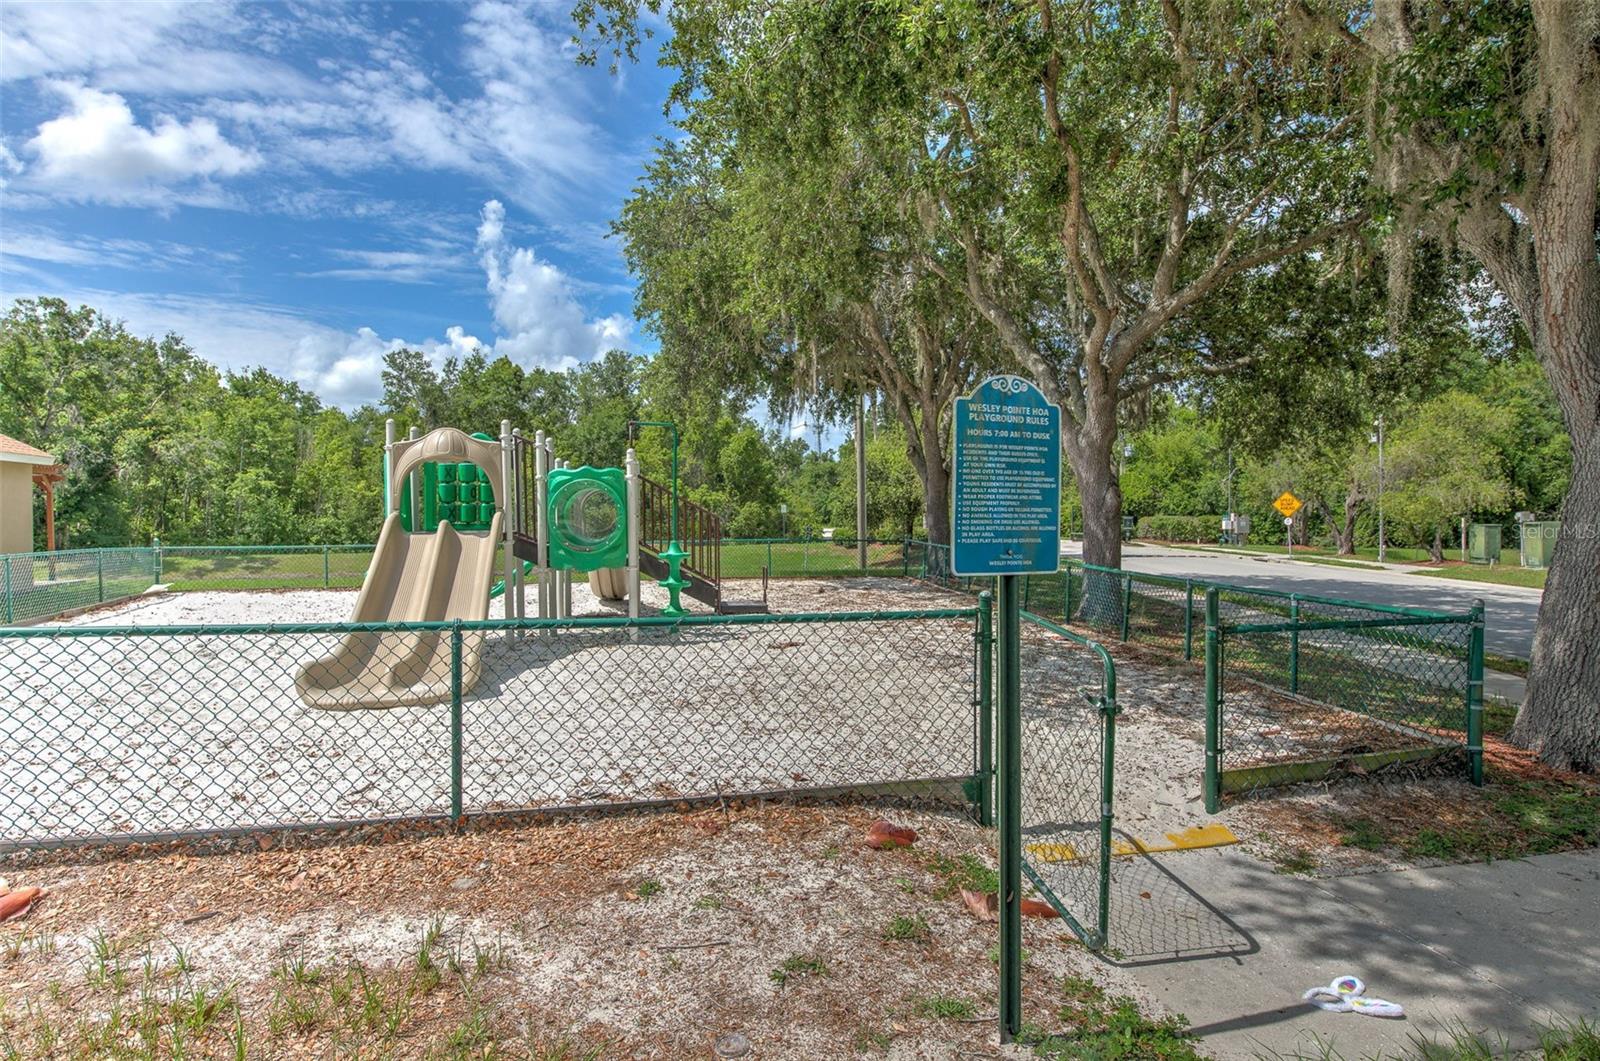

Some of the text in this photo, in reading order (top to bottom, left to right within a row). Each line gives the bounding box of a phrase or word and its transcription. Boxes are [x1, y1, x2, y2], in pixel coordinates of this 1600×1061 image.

[968, 403, 1049, 416] WESLEY POINTE HOA
[969, 413, 1049, 425] PLAYGROUND RULES
[967, 429, 992, 437] HOURS
[1033, 432, 1050, 440] DUSK
